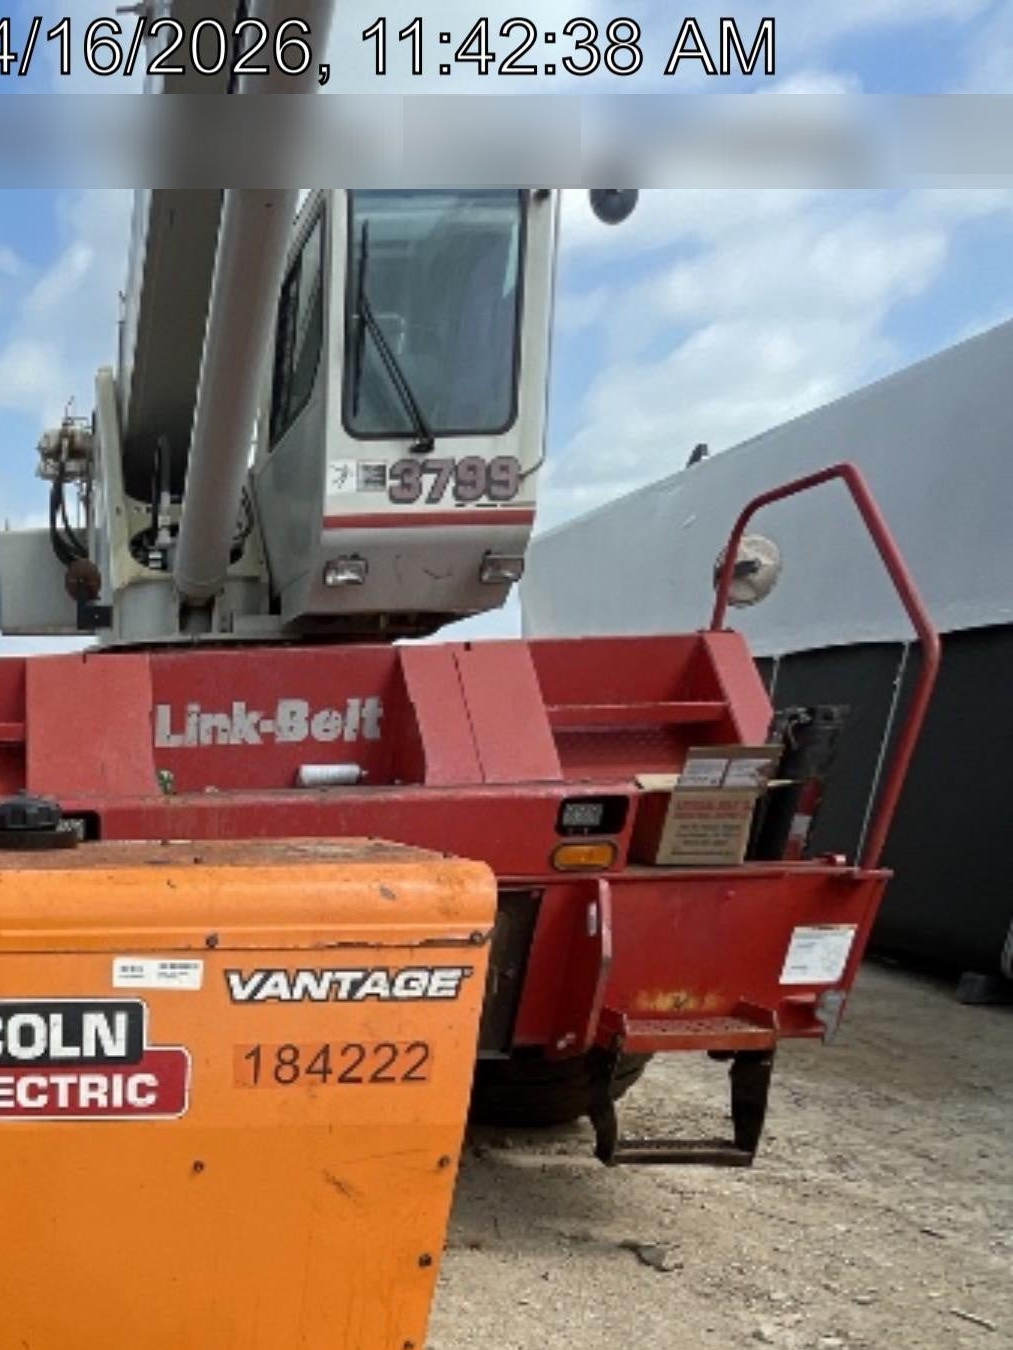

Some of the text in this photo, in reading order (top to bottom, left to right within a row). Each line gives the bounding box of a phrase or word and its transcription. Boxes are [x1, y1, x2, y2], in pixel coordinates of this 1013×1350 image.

[389, 456, 520, 504] 3799
[155, 697, 384, 748] Link-Belt
[226, 967, 466, 1003] VANTAGE
[244, 1040, 431, 1085] 184222
